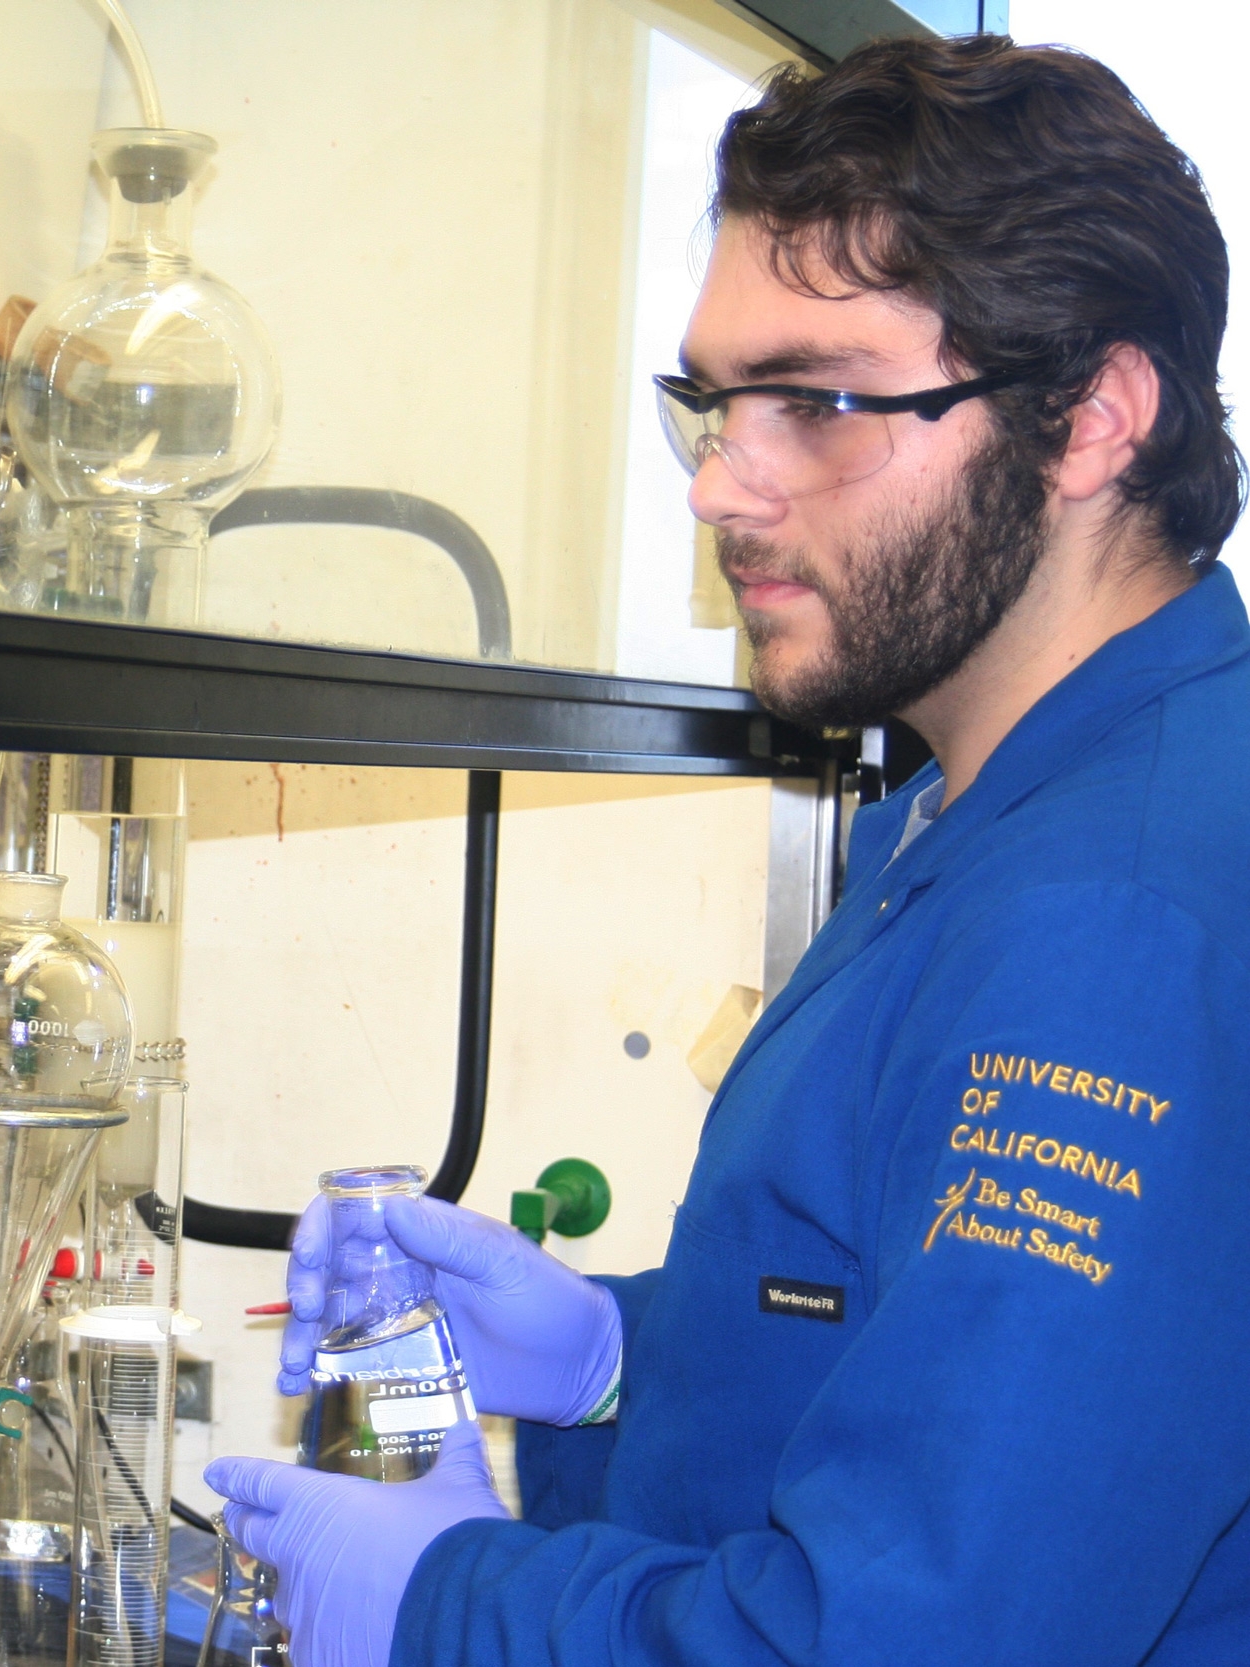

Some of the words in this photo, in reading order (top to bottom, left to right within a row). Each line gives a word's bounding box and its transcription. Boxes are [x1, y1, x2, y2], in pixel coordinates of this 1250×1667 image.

[961, 1087, 1000, 1116] OF
[970, 1053, 1171, 1123] UNIVERSITY
[950, 1124, 1141, 1199] CALIFORNIA
[973, 1177, 1011, 1209] Be
[1015, 1187, 1101, 1240] Smart
[946, 1211, 1022, 1249] About
[1024, 1228, 1112, 1285] Safety
[276, 1643, 289, 1654] 50
